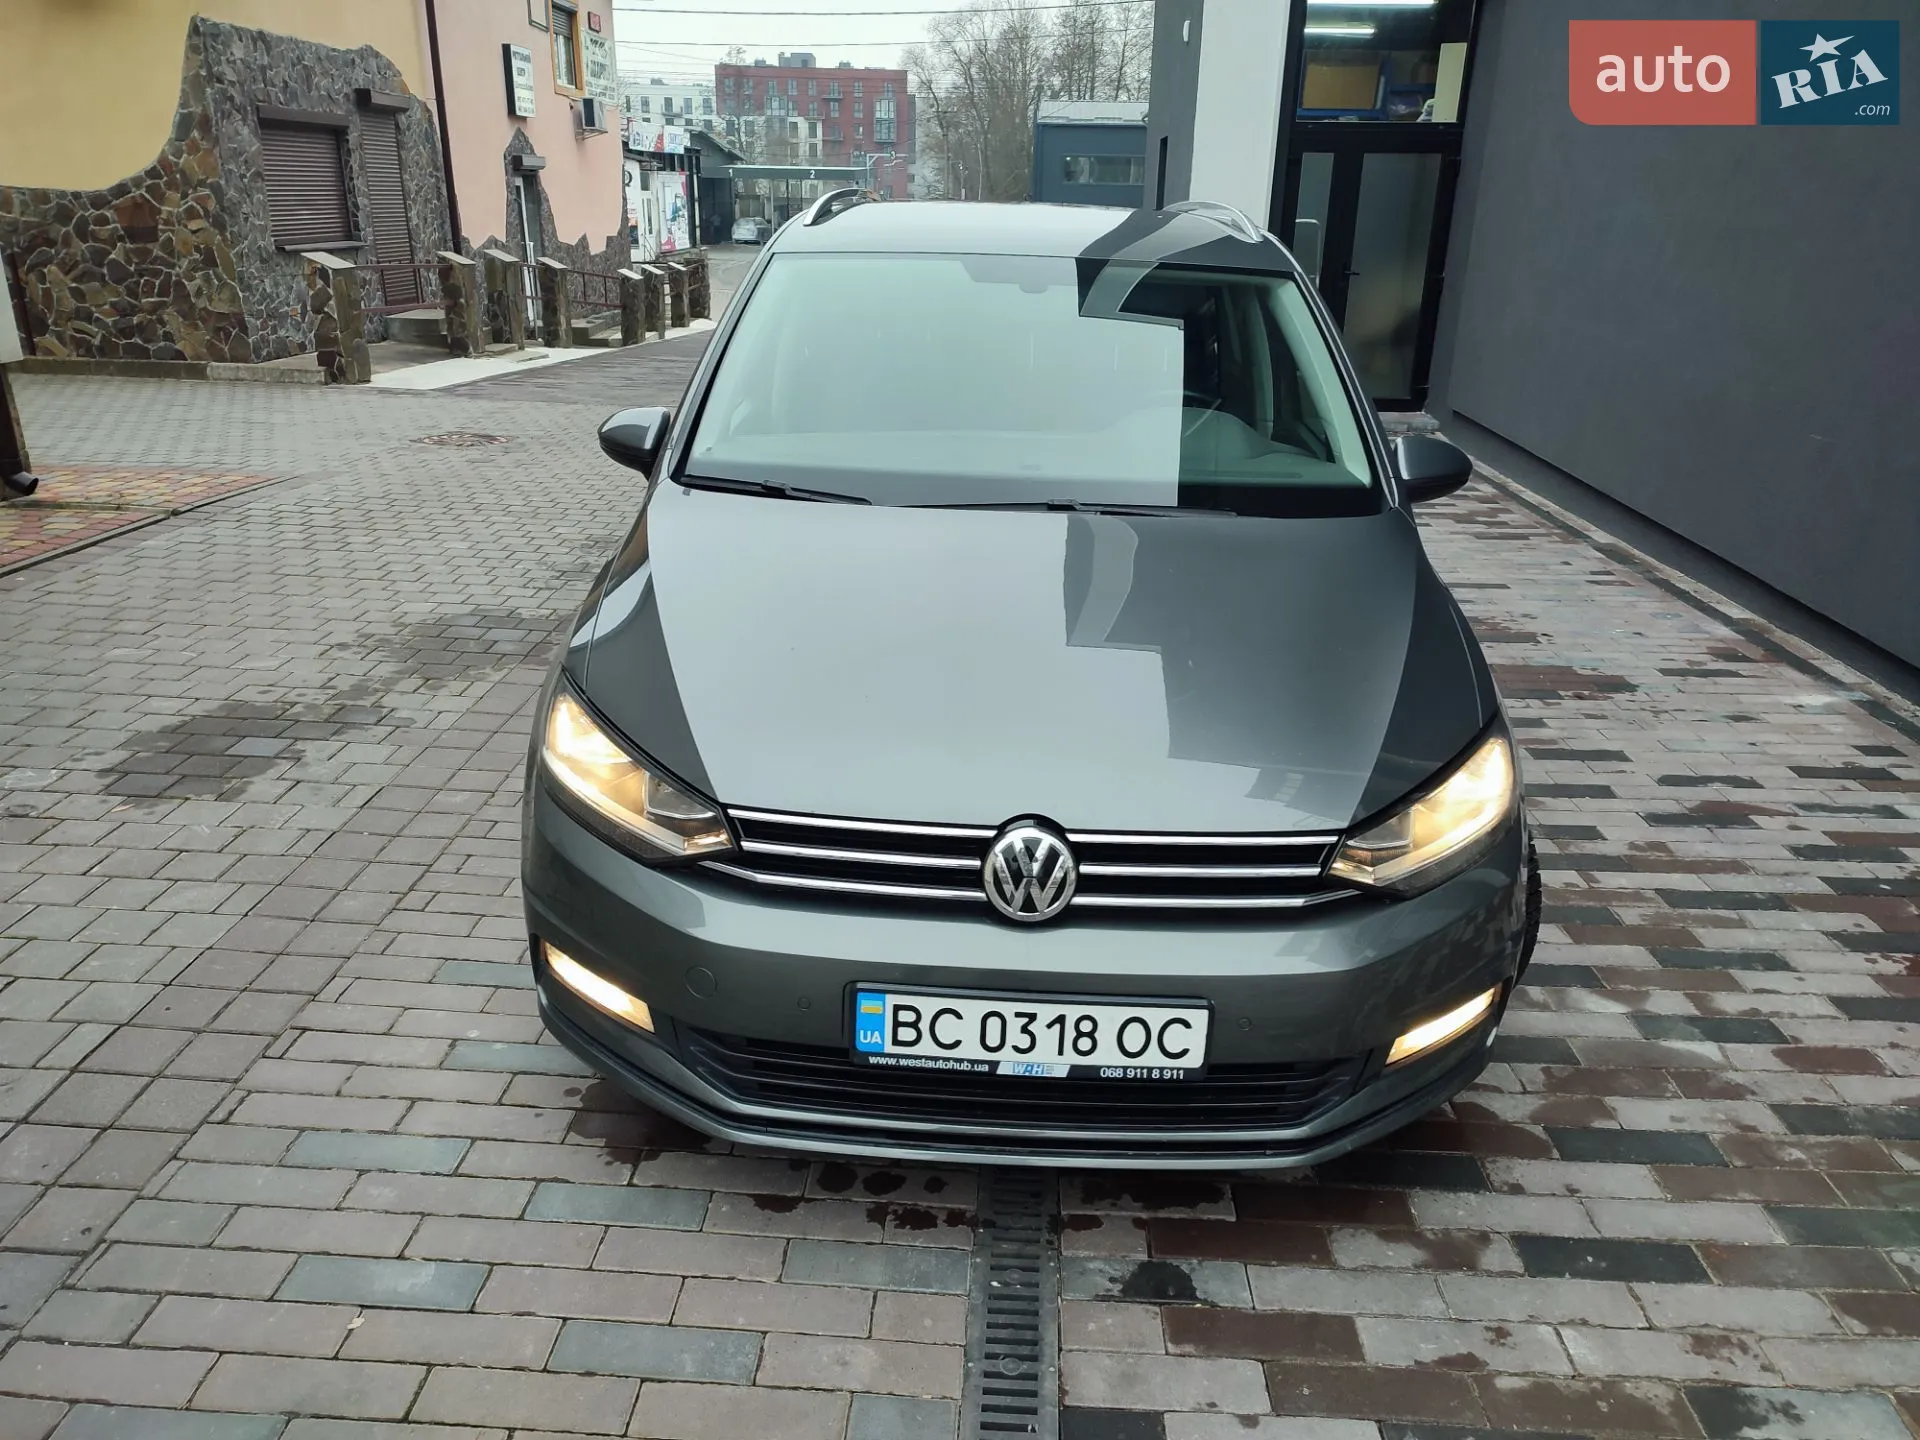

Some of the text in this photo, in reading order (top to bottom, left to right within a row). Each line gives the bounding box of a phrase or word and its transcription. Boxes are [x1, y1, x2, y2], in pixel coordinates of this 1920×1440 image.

[810, 170, 815, 178] 2
[859, 1030, 882, 1044] UA
[892, 1004, 1193, 1060] BC 0318 OC
[868, 1055, 989, 1072] www.westautohub.ua
[1100, 1067, 1185, 1080] 068 911 8 911
